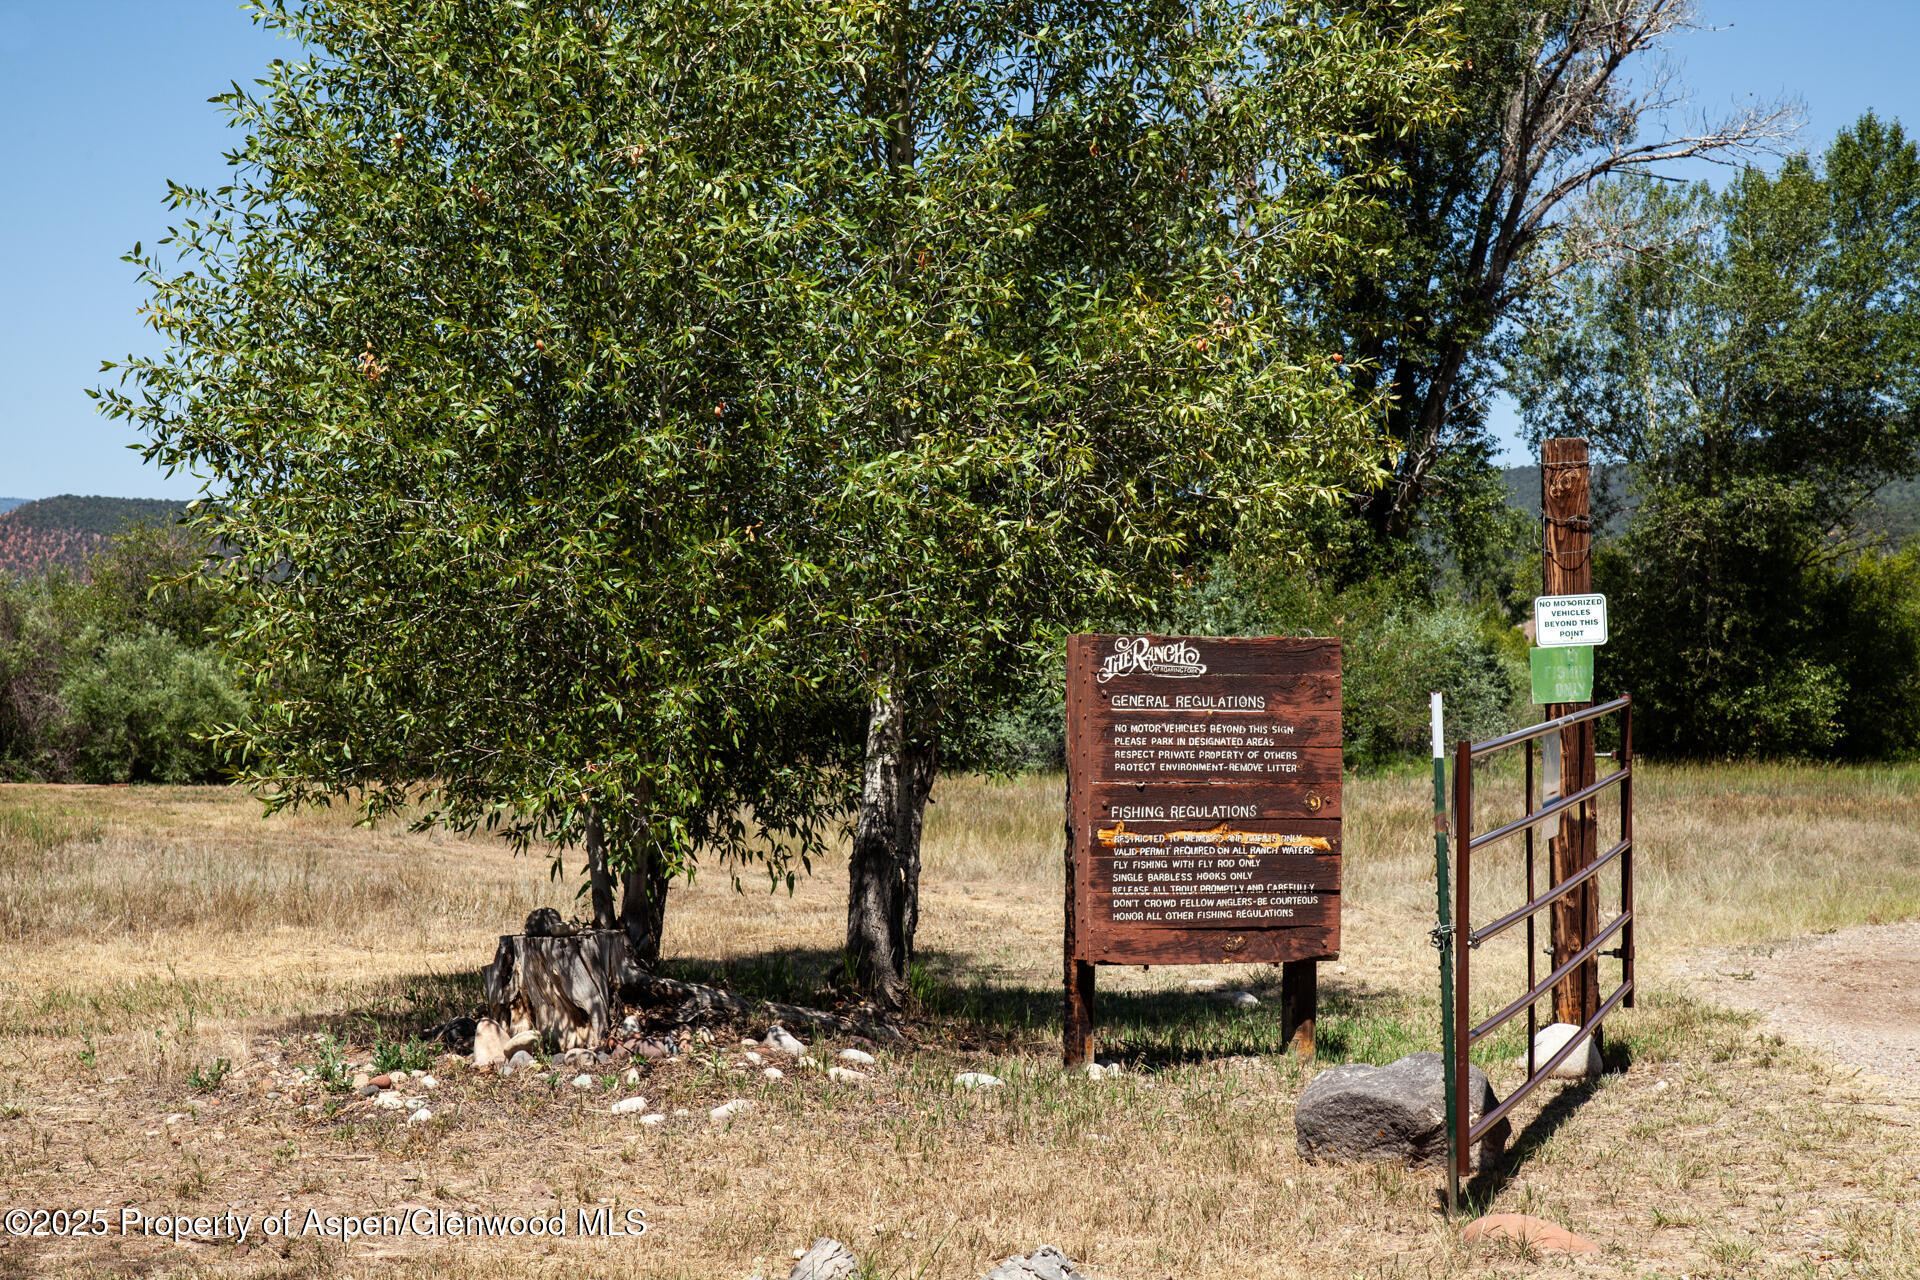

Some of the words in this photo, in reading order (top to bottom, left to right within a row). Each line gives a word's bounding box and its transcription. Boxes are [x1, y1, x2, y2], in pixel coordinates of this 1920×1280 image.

[1552, 608, 1590, 617] VEHICLES
[1544, 620, 1578, 628] BEYOND
[1100, 649, 1132, 678] THE
[1131, 637, 1200, 671] RANCH
[1555, 682, 1586, 697] ONLY
[1111, 695, 1170, 707] GENERAL
[1176, 695, 1265, 708] REGULATIONS
[1115, 724, 1127, 733] NO
[1130, 724, 1161, 733] MOTOR
[1164, 724, 1206, 733] VEHICLES
[1210, 724, 1246, 734] BEYOND
[1249, 725, 1268, 734] THIS
[1272, 725, 1294, 734] SIGN
[1115, 738, 1147, 746] PLEASE
[1152, 738, 1174, 746] PARK
[1177, 738, 1186, 746] IN
[1188, 737, 1243, 746] DESIGNATED
[1246, 738, 1274, 746] AREAS
[1115, 750, 1155, 759] RESPECT
[1159, 750, 1195, 759] PRIVATE
[1199, 751, 1244, 759] PROPERTY
[1247, 751, 1259, 759] OF
[1264, 752, 1297, 760] OTHERS
[1115, 763, 1156, 771] PROTECT
[1267, 764, 1297, 772] LITTER
[1111, 806, 1164, 818] FISHING
[1171, 805, 1257, 818] REGULATIONS
[1114, 835, 1165, 843] RESTRICTED
[1280, 834, 1302, 842] ONLY
[1114, 847, 1137, 855] VALID
[1140, 847, 1170, 855] PERMIT
[1174, 846, 1215, 855] REQUIRED
[1217, 846, 1229, 854] ON
[1232, 846, 1247, 854] ALL
[1250, 846, 1278, 854] RANCH
[1282, 846, 1314, 854] WATERS
[1113, 860, 1128, 869] FLY
[1133, 860, 1167, 869] FISHING
[1172, 860, 1194, 868] WITH
[1198, 859, 1213, 868] FLY
[1218, 859, 1235, 868] ROD
[1239, 859, 1261, 868] ONLY
[1113, 873, 1143, 882] SINGLE
[1148, 873, 1192, 882] BARBLESS
[1197, 872, 1226, 881] HOOKS
[1230, 872, 1252, 881] ONLY
[1112, 886, 1148, 895] RELEASE
[1153, 886, 1169, 895] ALL
[1170, 885, 1198, 895] TROUT
[1200, 884, 1244, 894] PROMPTLY
[1247, 884, 1263, 893] AND
[1267, 883, 1314, 893] CAREFULLY
[1113, 899, 1139, 908] DON'T
[1144, 899, 1176, 907] CROWD
[1180, 899, 1214, 907] FELLOW
[1270, 896, 1318, 905] COURTEOUS
[1113, 912, 1144, 921] HONOR
[1146, 912, 1162, 920] ALL
[1166, 911, 1193, 920] OTHER
[1197, 910, 1232, 919] FISHING
[1236, 909, 1294, 918] REGULATIONS
